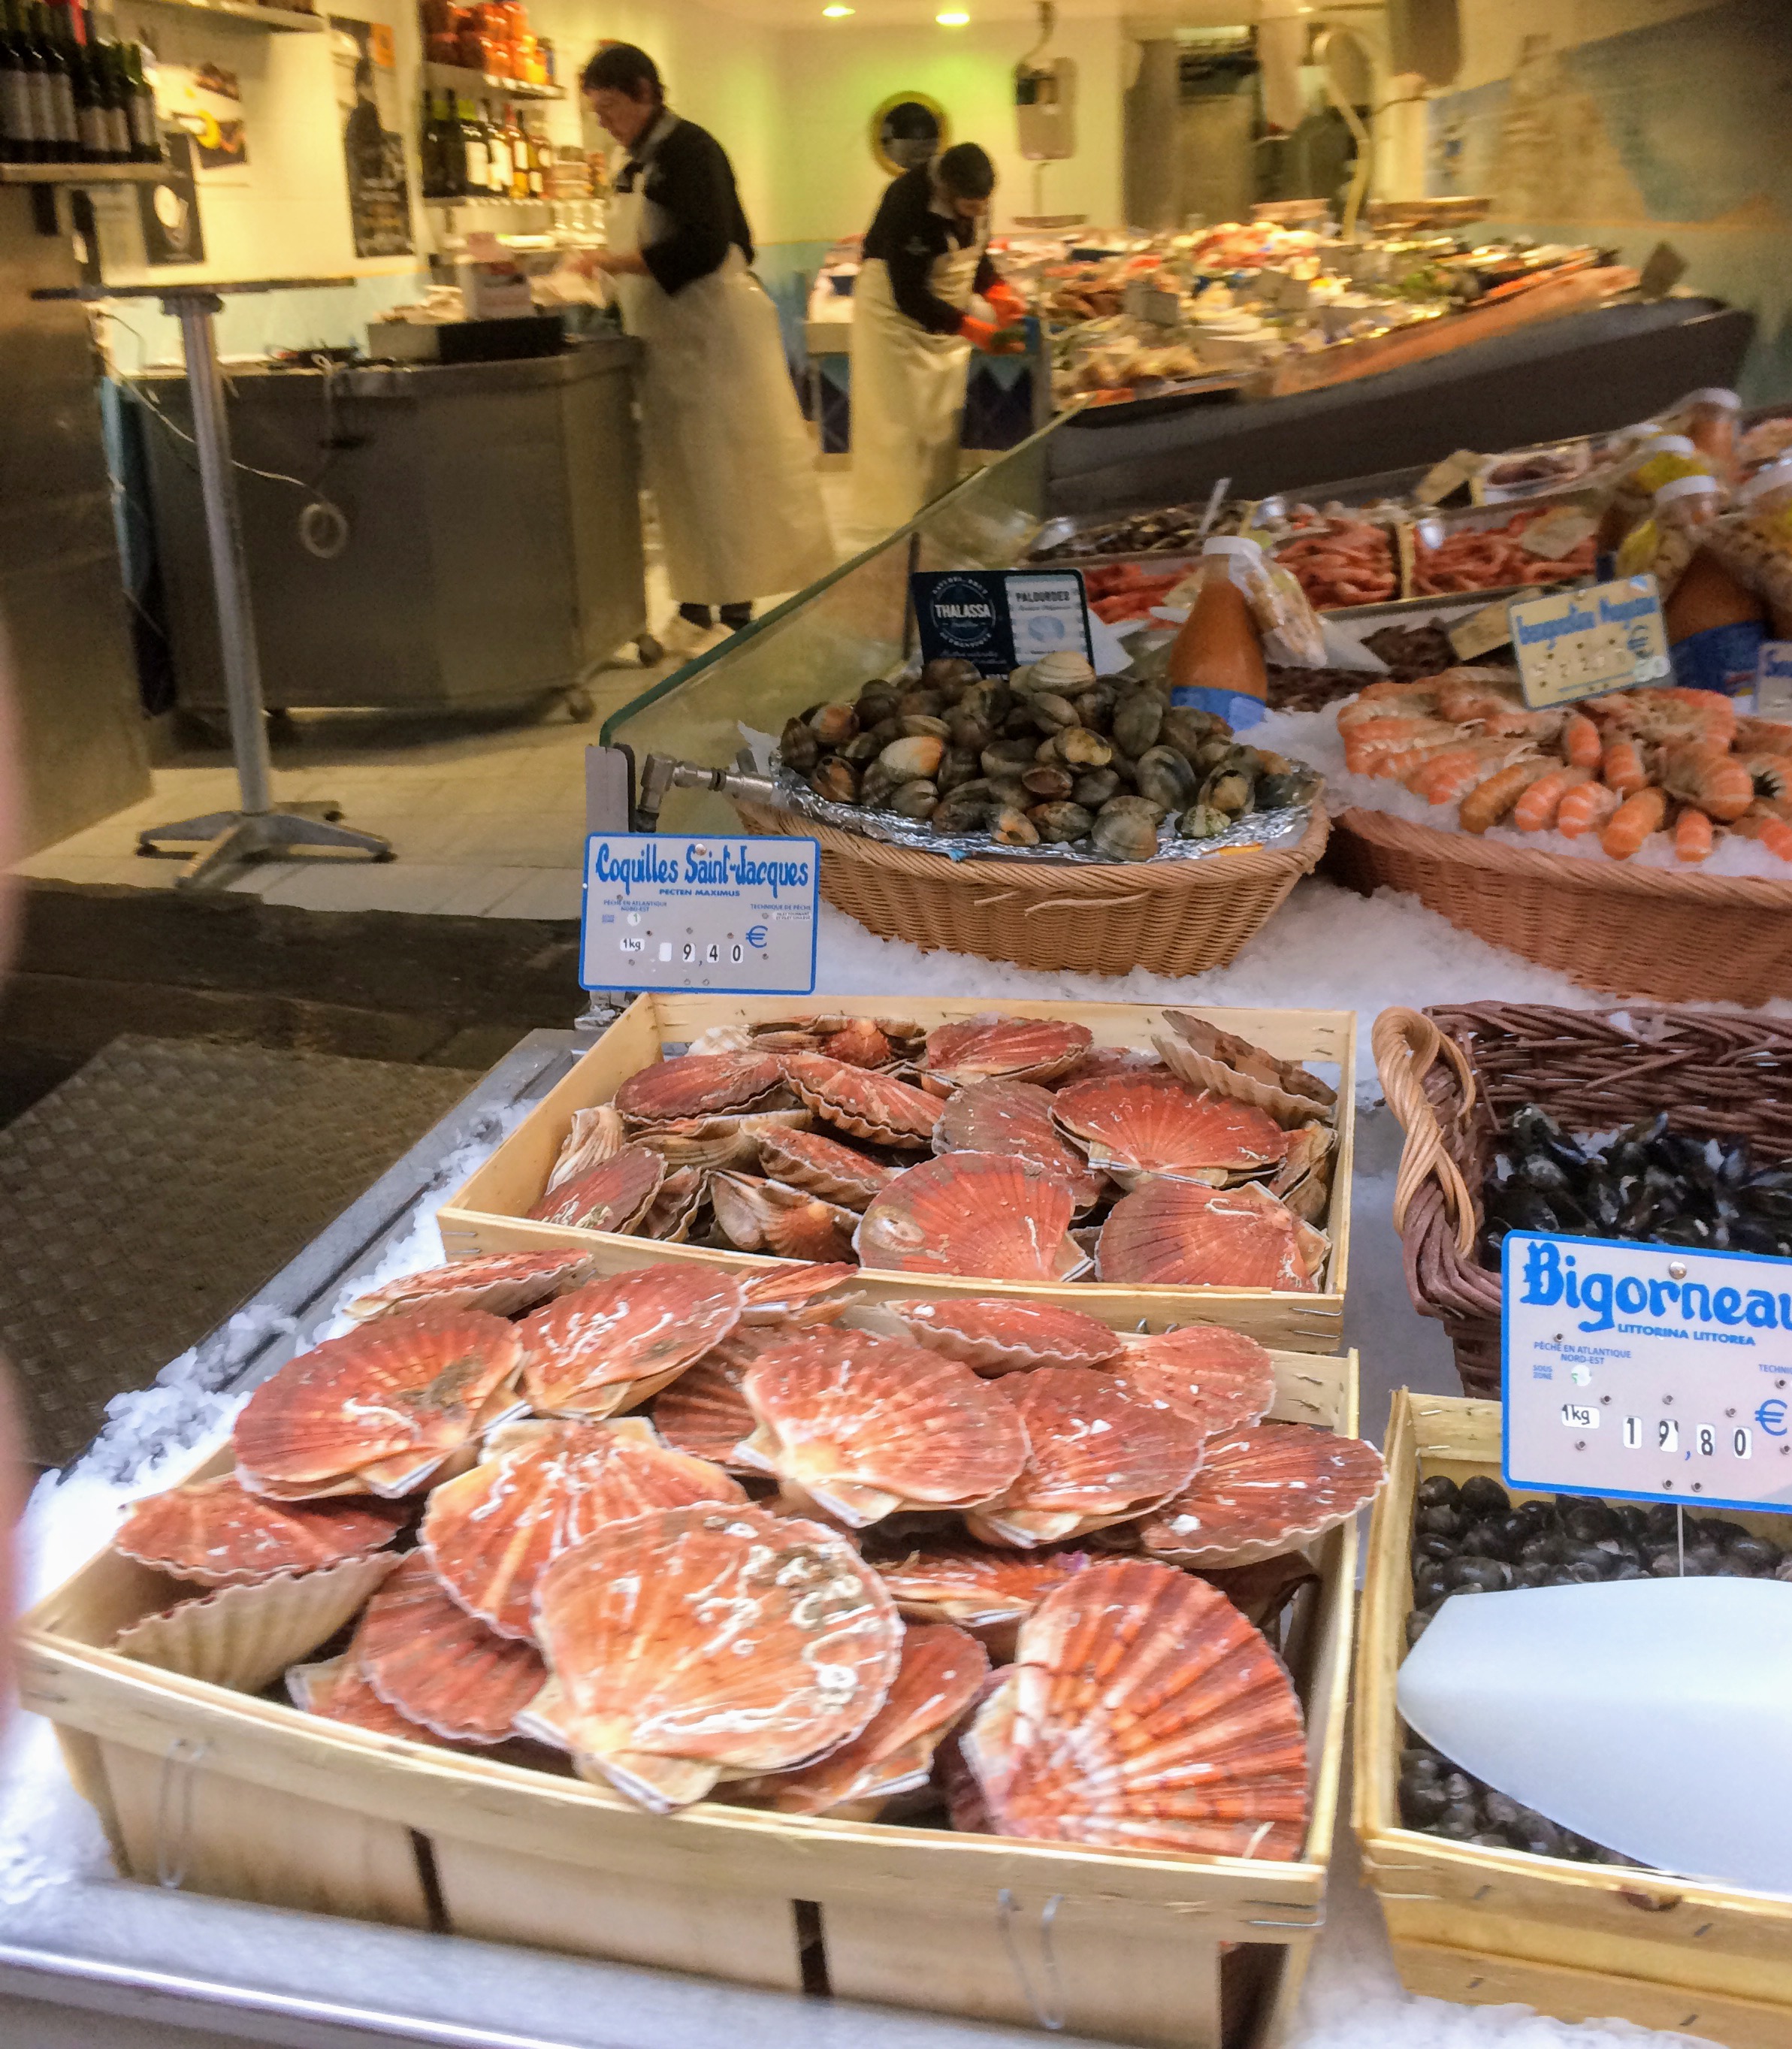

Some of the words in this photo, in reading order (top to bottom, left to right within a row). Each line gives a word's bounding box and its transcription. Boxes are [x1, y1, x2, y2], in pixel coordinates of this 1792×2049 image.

[934, 603, 992, 618] THALASSA
[595, 842, 678, 896] Coquilles
[684, 844, 808, 899] Saint-Jacques
[623, 938, 641, 952] 1kg
[1618, 1323, 1689, 1339] LITTORINA
[1693, 1331, 1756, 1346] LITTOREA
[1534, 1341, 1562, 1352] PÊCHE
[1564, 1344, 1576, 1352] EN
[1577, 1346, 1632, 1358] ATLANTIQUE
[1560, 1353, 1605, 1364] NORD-EST
[1562, 1404, 1591, 1425] 1kg
